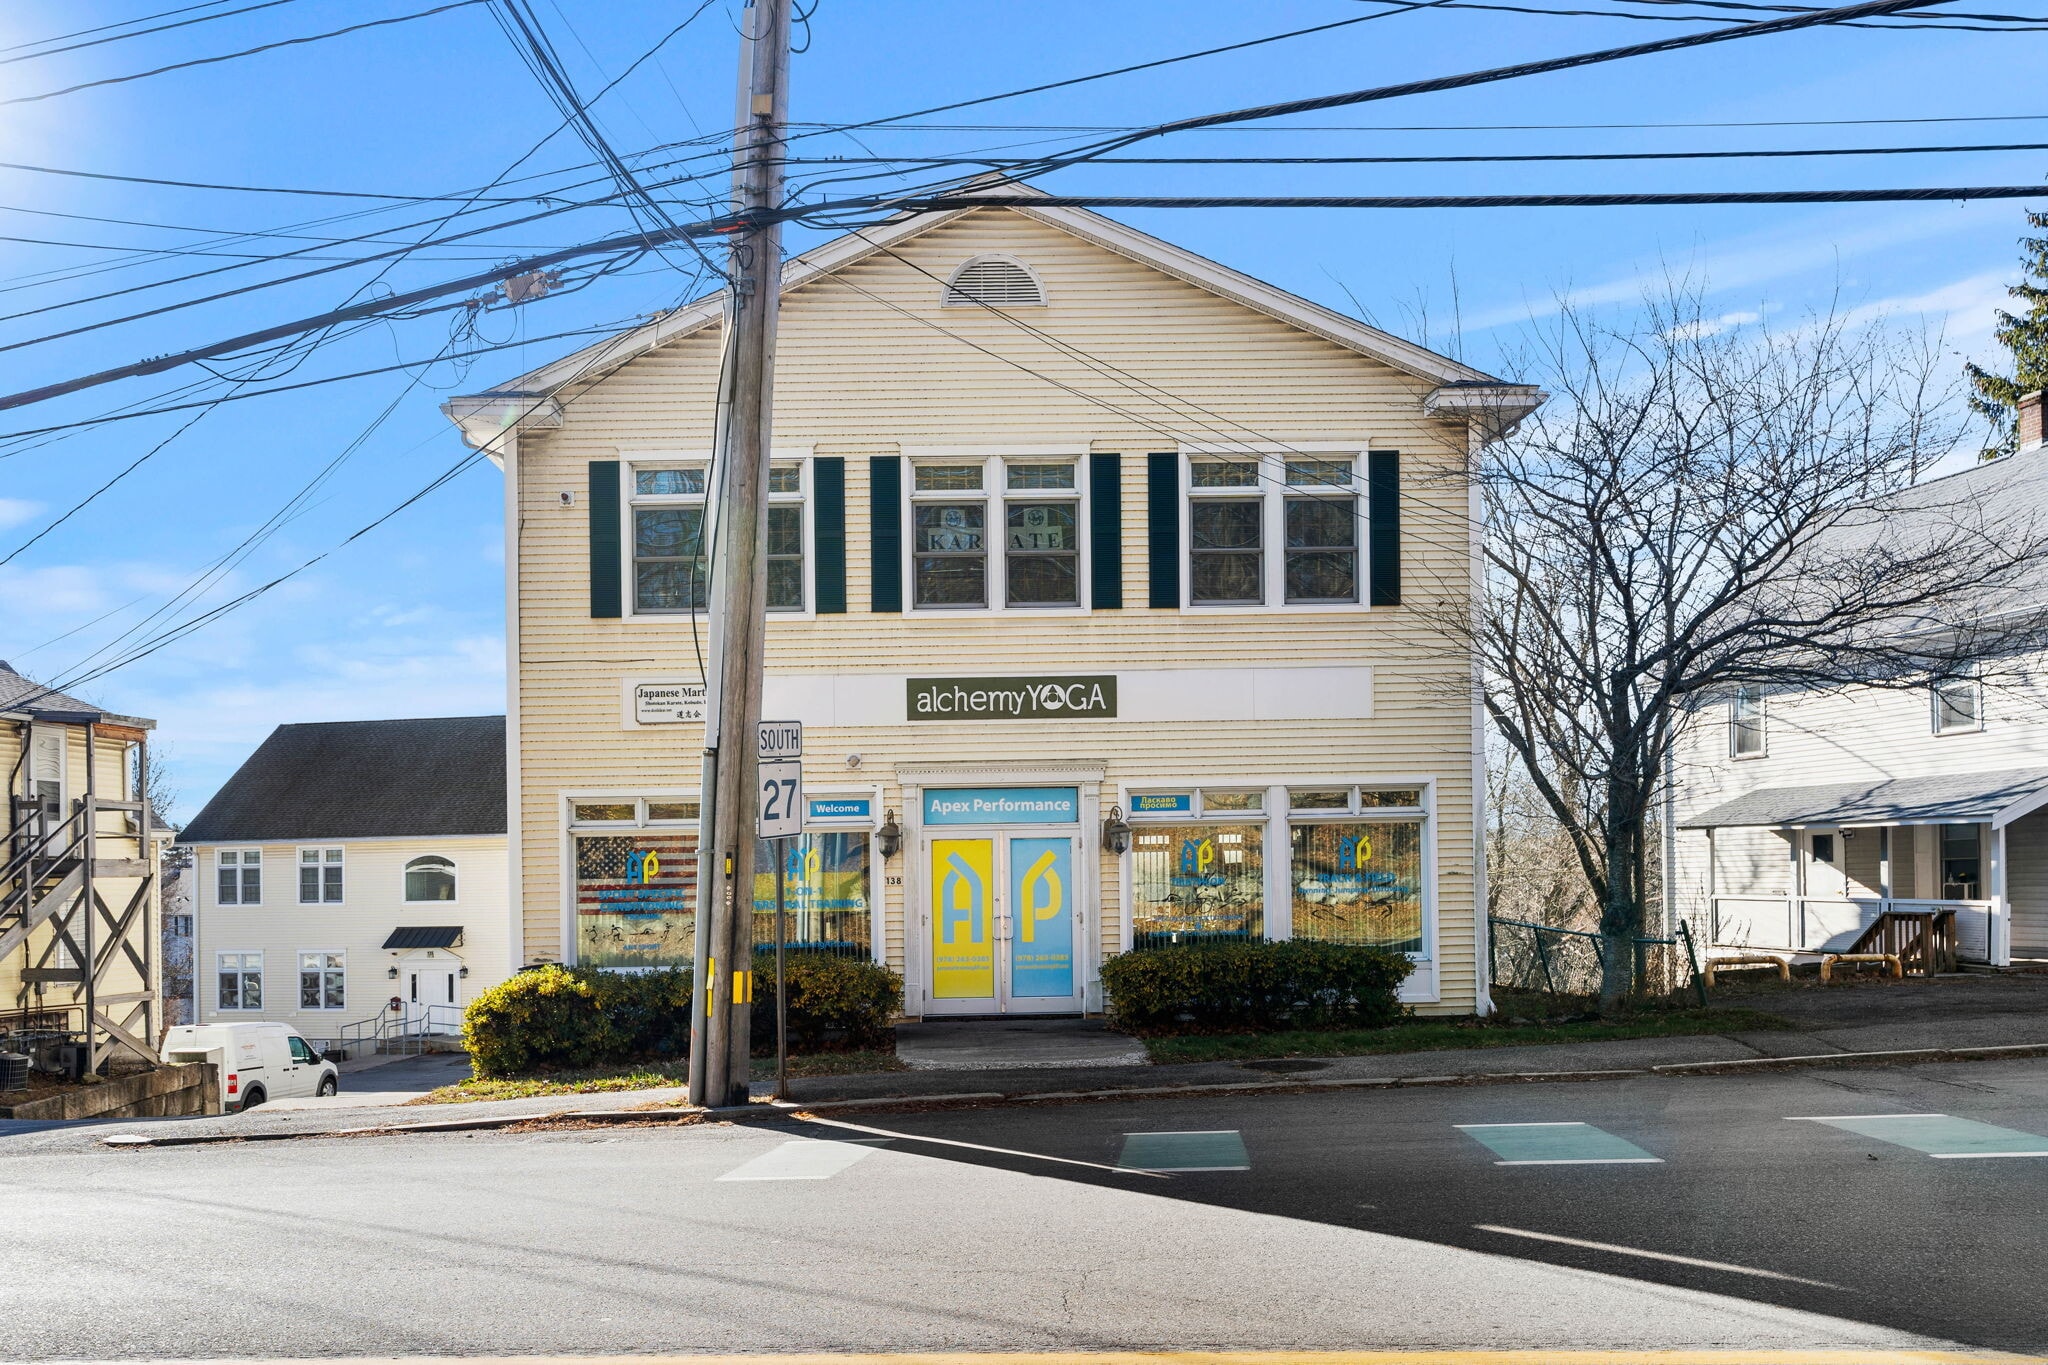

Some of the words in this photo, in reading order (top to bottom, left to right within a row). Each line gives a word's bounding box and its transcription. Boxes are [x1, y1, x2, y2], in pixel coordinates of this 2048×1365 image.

[638, 688, 680, 700] Japanese
[761, 729, 799, 750] SOUTH
[764, 779, 797, 820] 27
[1141, 796, 1176, 804] Ласкаво
[816, 804, 860, 813] Welcome
[931, 800, 970, 815] Apex
[974, 798, 1070, 812] Performance
[1140, 802, 1177, 811] просимо
[886, 877, 902, 885] 138
[1317, 873, 1351, 883] TRACK
[752, 900, 808, 911] ERSNAL
[810, 898, 863, 909] TRAINING
